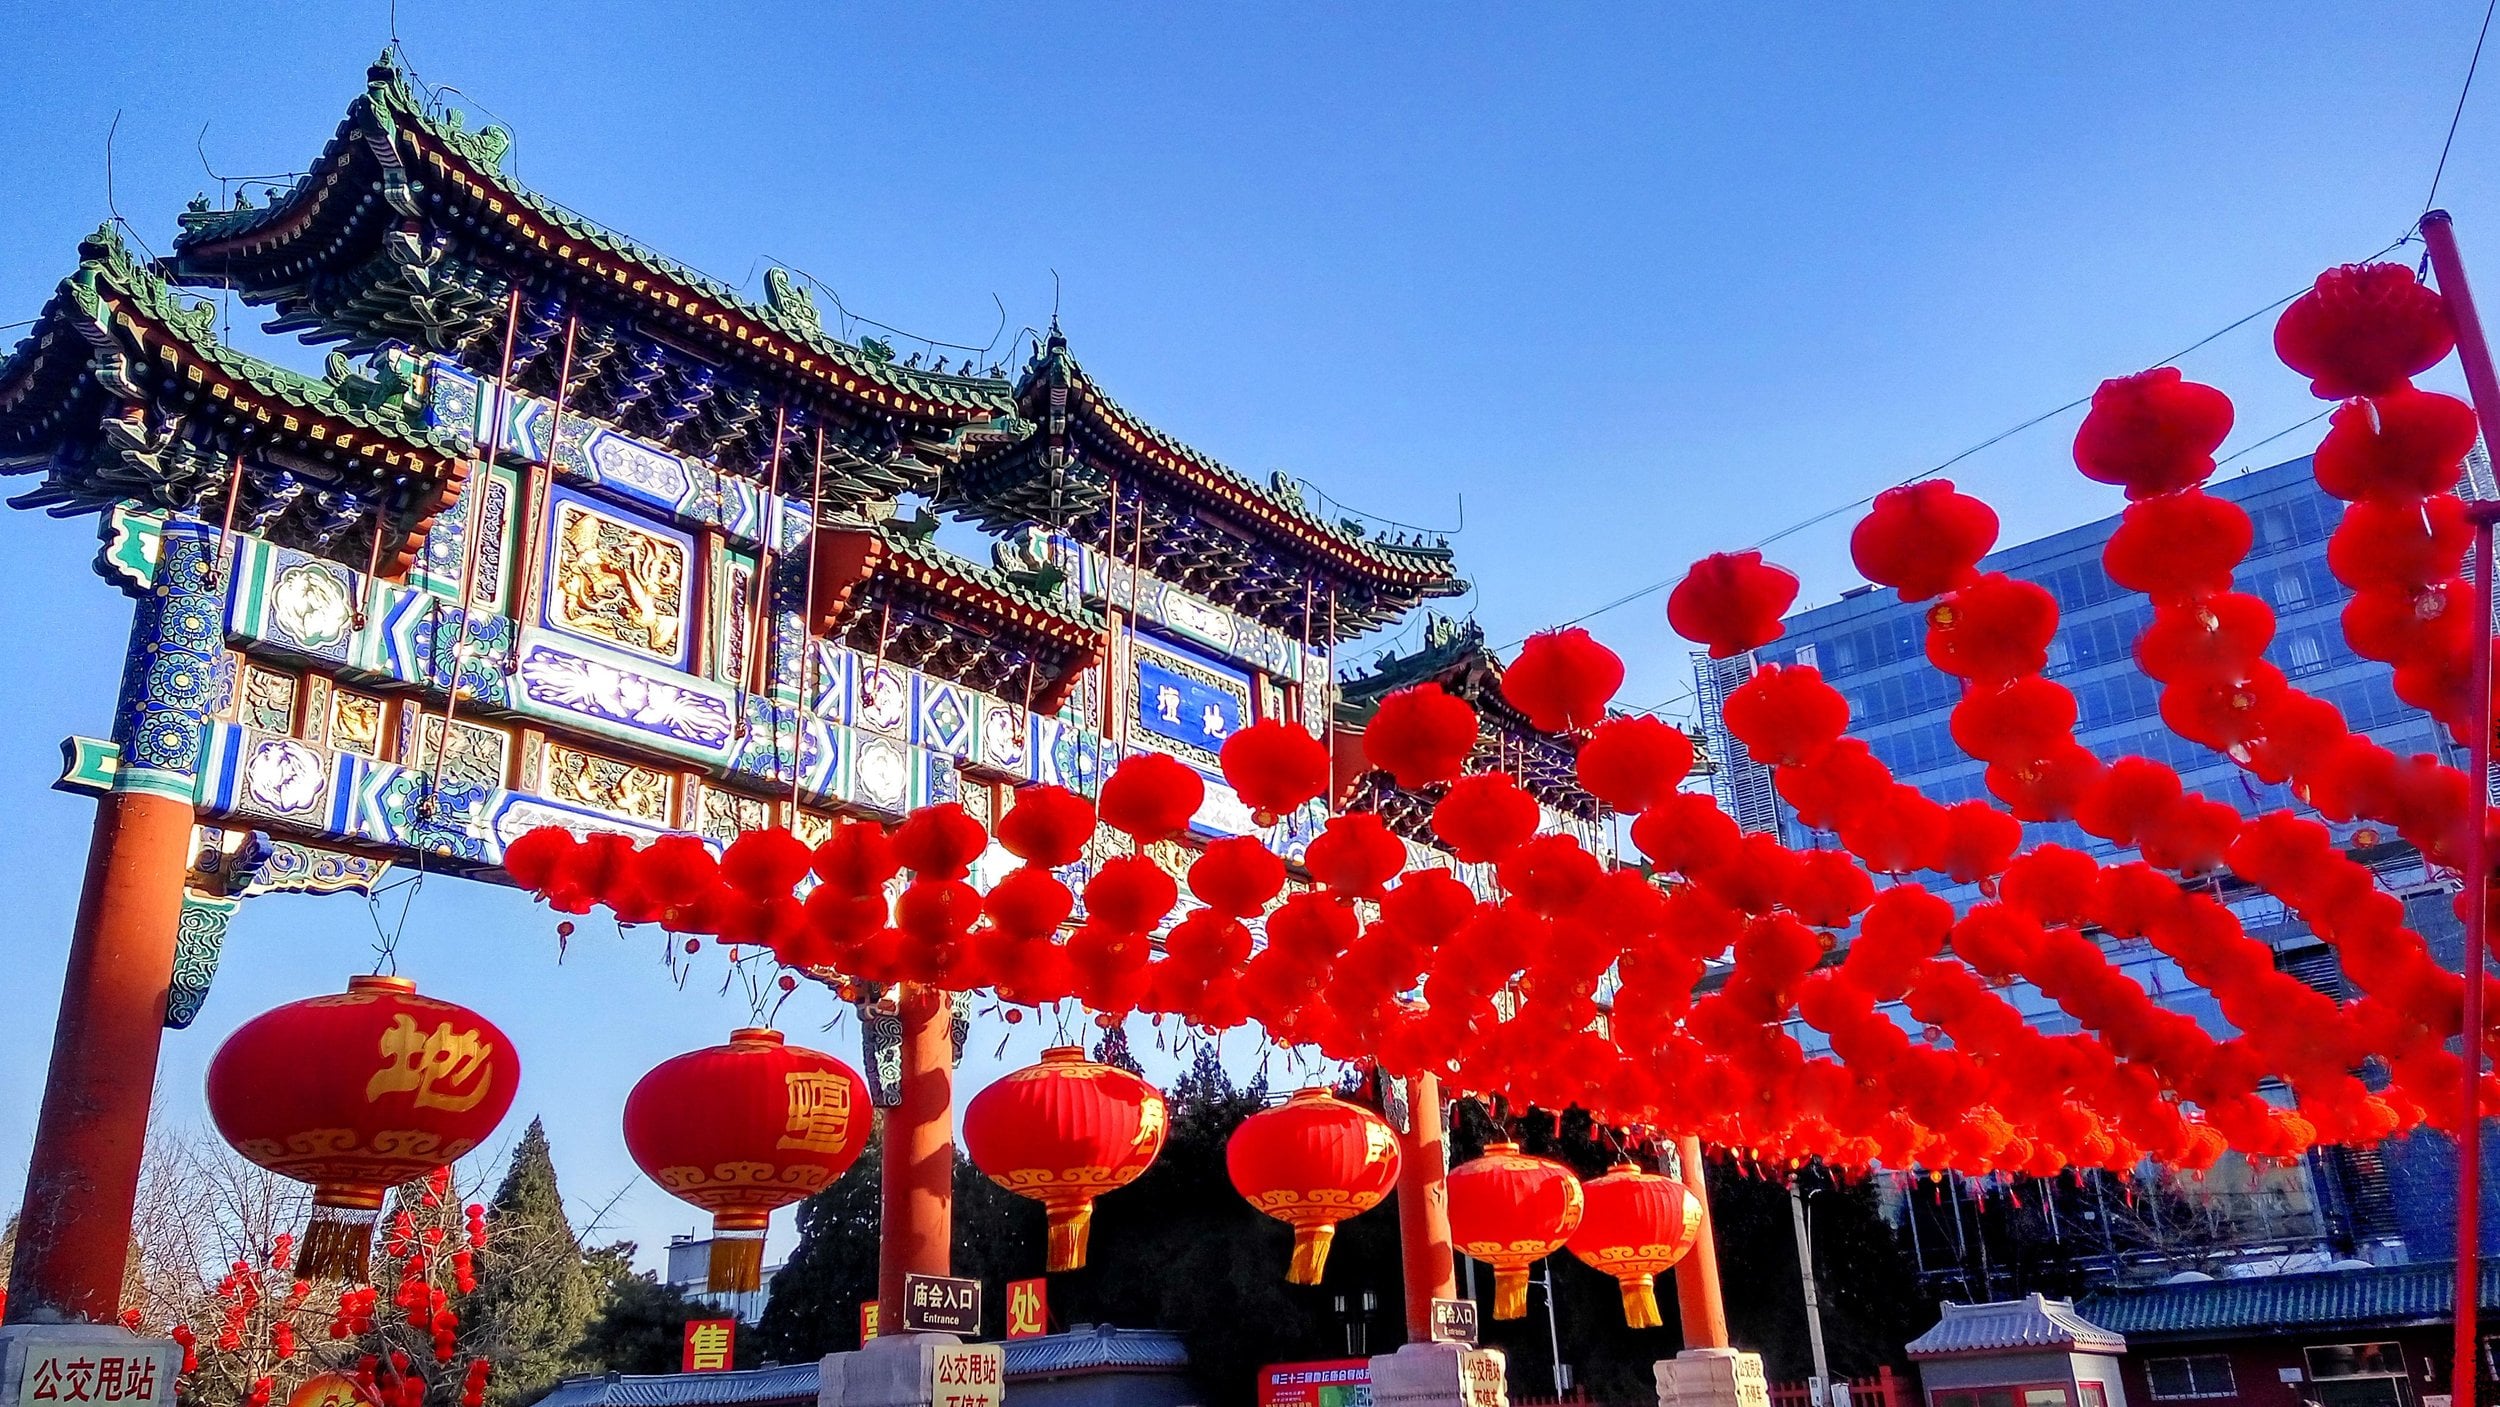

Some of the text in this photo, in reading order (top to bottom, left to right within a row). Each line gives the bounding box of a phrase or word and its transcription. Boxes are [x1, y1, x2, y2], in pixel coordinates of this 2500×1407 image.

[913, 1282, 973, 1310] 庙会入口
[1010, 1283, 1041, 1336] 处
[923, 1312, 960, 1326] Entrance
[689, 1324, 730, 1370] 售
[33, 1356, 156, 1402] 公交甩站
[939, 1353, 996, 1385] 公交甩站
